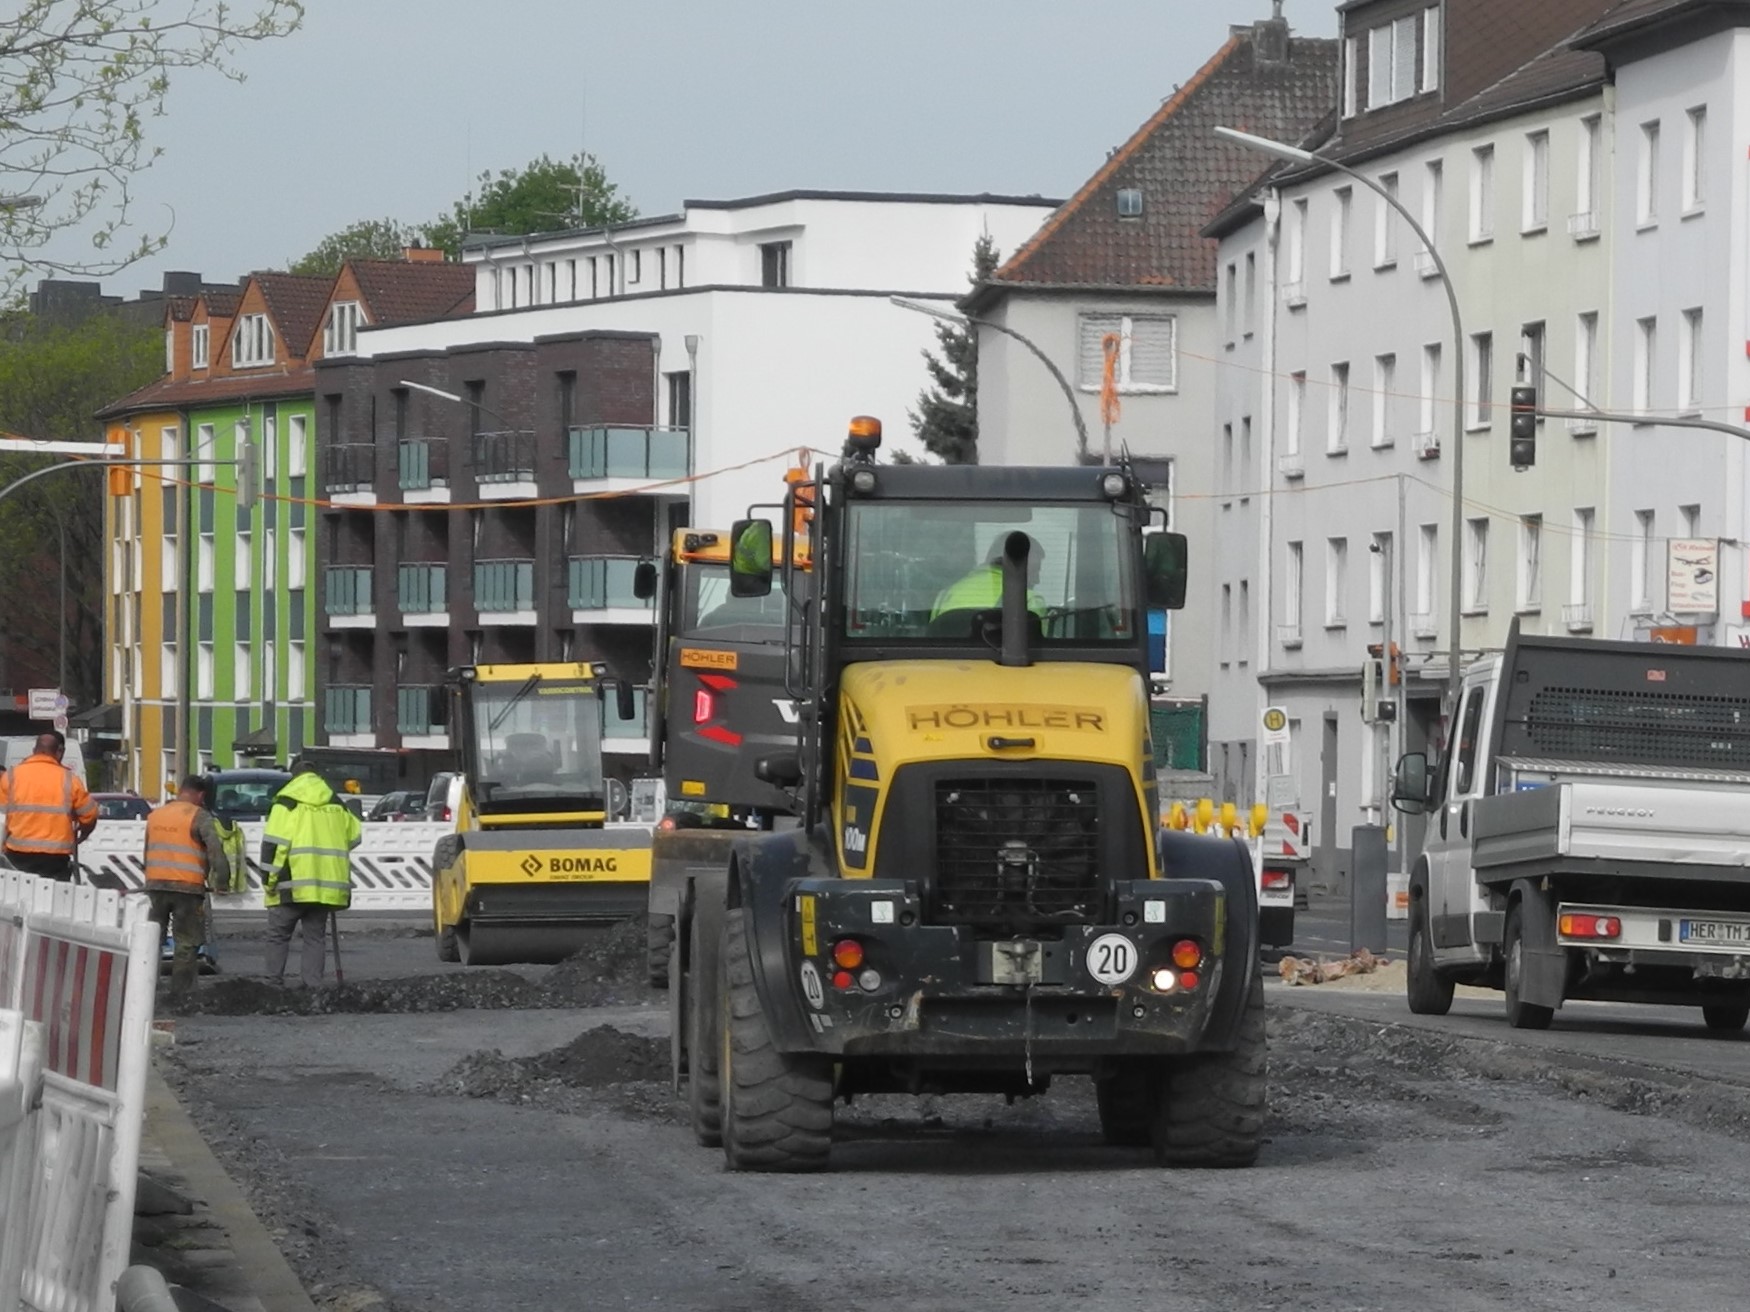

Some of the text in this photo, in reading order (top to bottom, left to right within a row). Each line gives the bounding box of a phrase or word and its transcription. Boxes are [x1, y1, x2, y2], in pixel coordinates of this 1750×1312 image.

[905, 704, 1104, 731] HÖHLER
[1586, 806, 1656, 818] PEUGEOT
[549, 857, 617, 873] BOMAG
[1690, 922, 1716, 939] HER
[1725, 924, 1741, 940] TM
[1098, 944, 1127, 974] 20
[803, 969, 820, 999] 20
